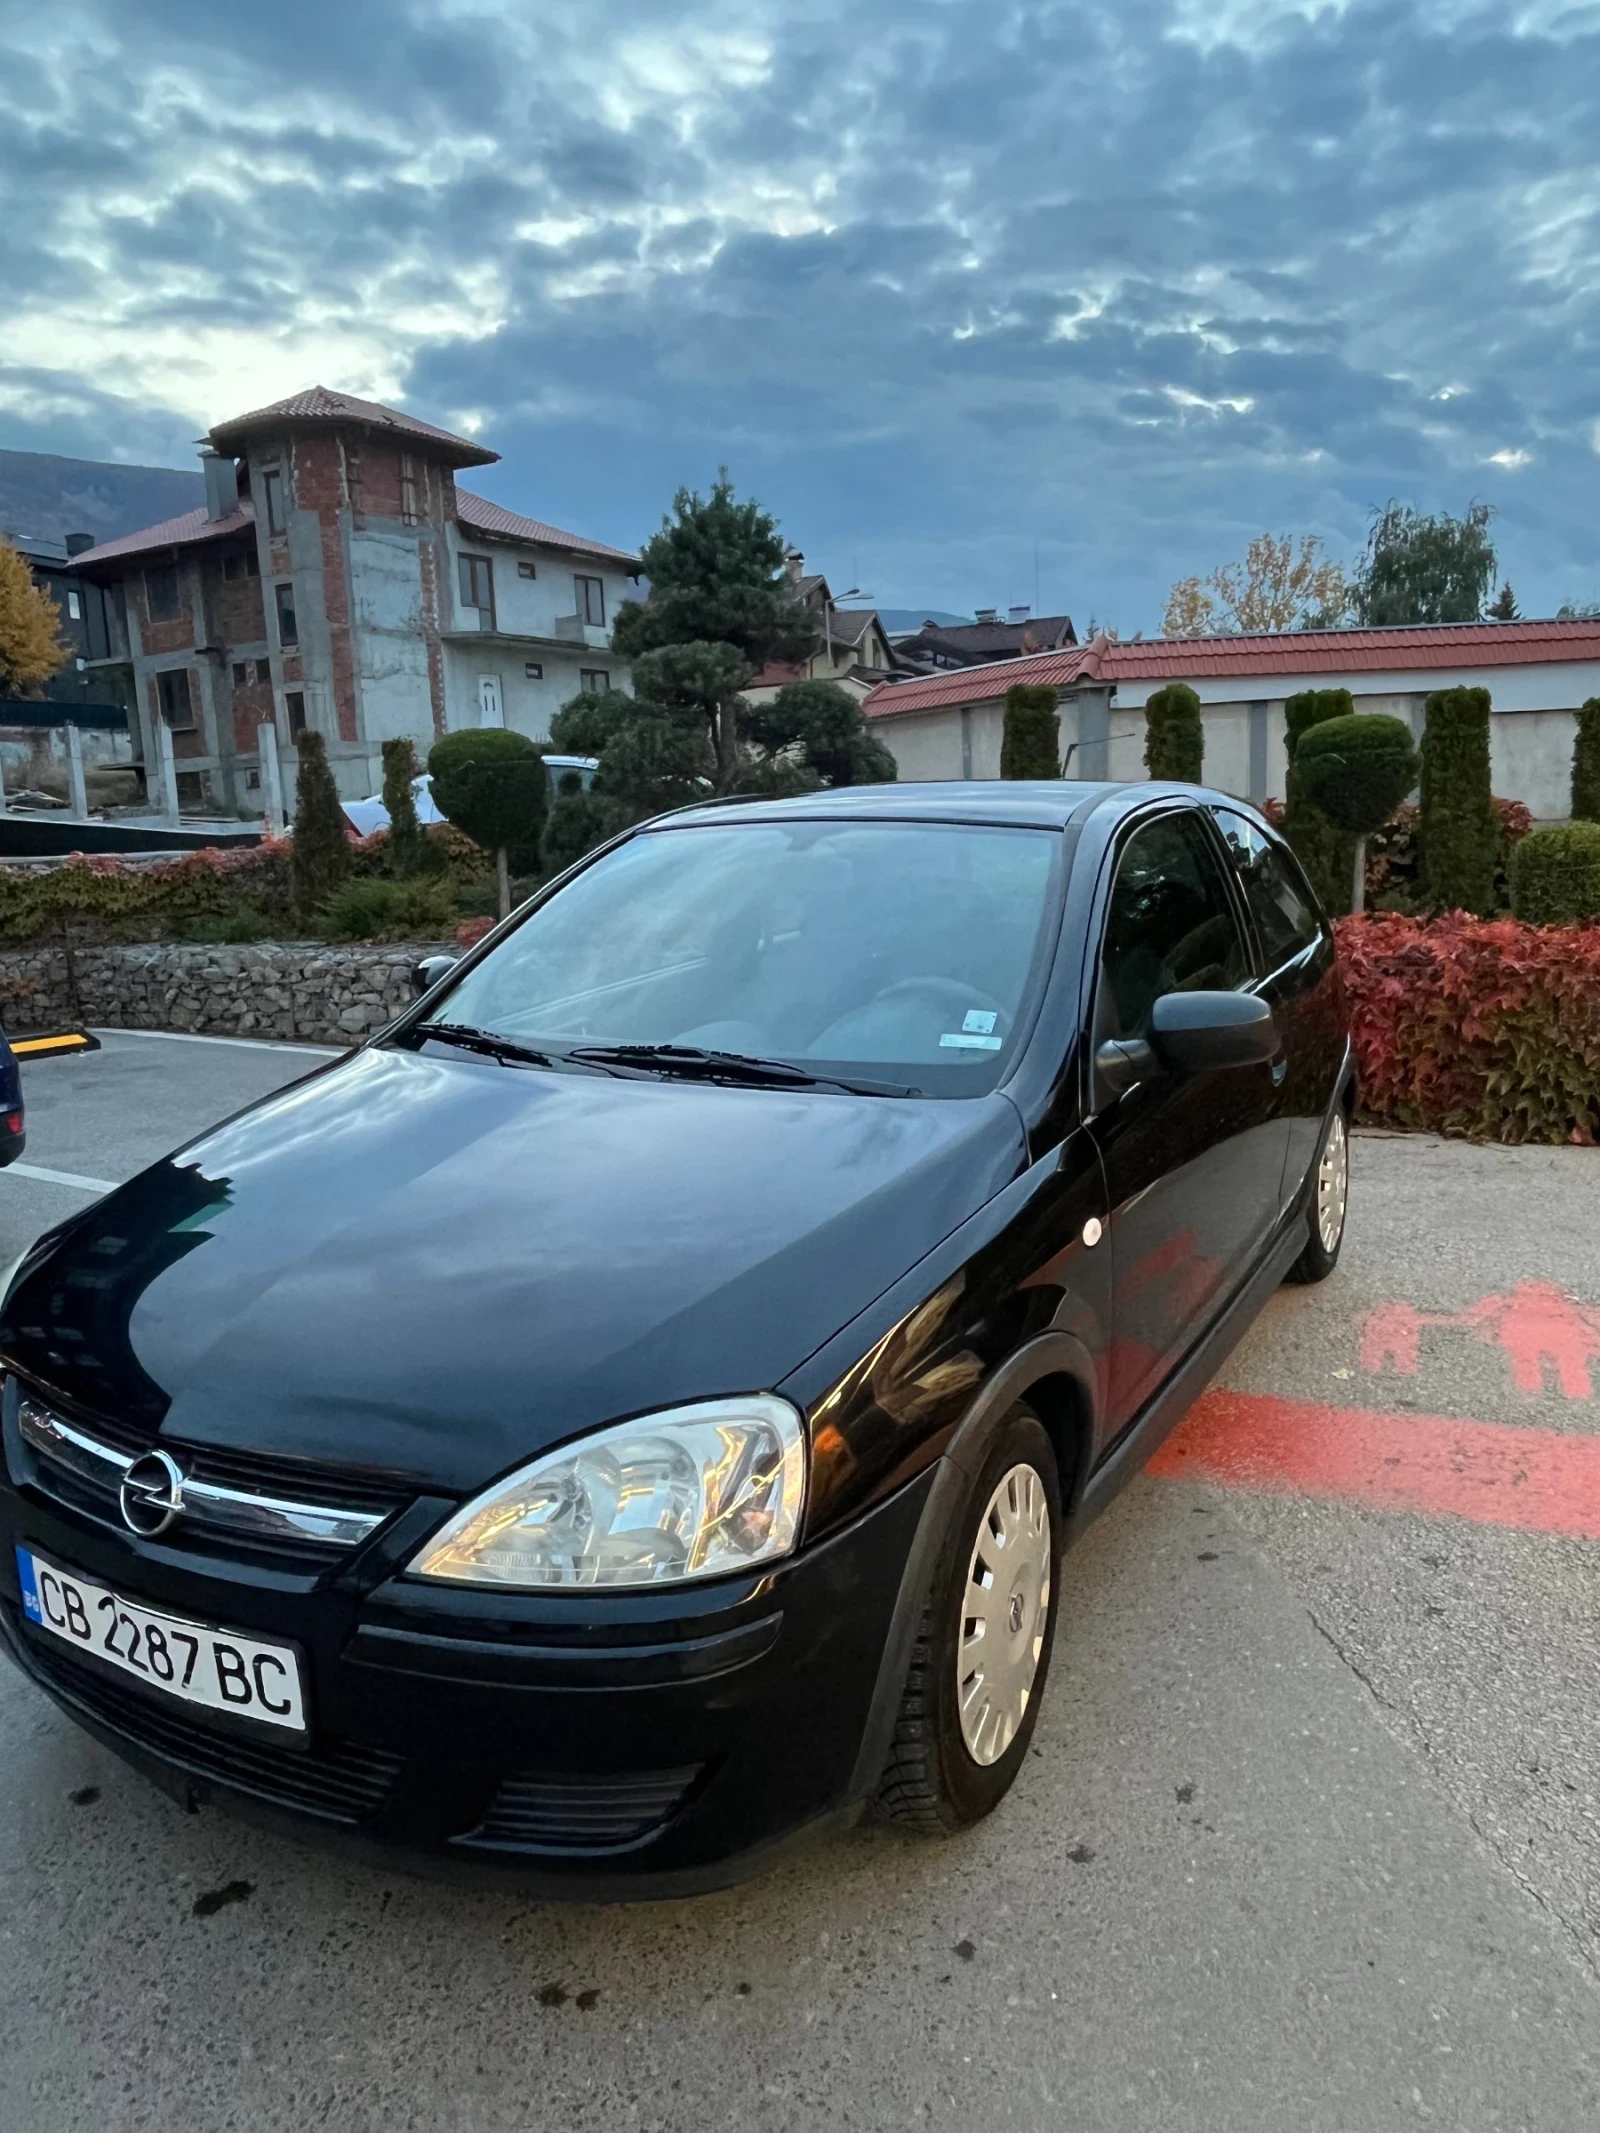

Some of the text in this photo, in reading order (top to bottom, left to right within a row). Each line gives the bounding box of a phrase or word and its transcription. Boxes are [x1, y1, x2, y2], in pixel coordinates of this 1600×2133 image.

[40, 1571, 291, 1715] CB 2287 BC
